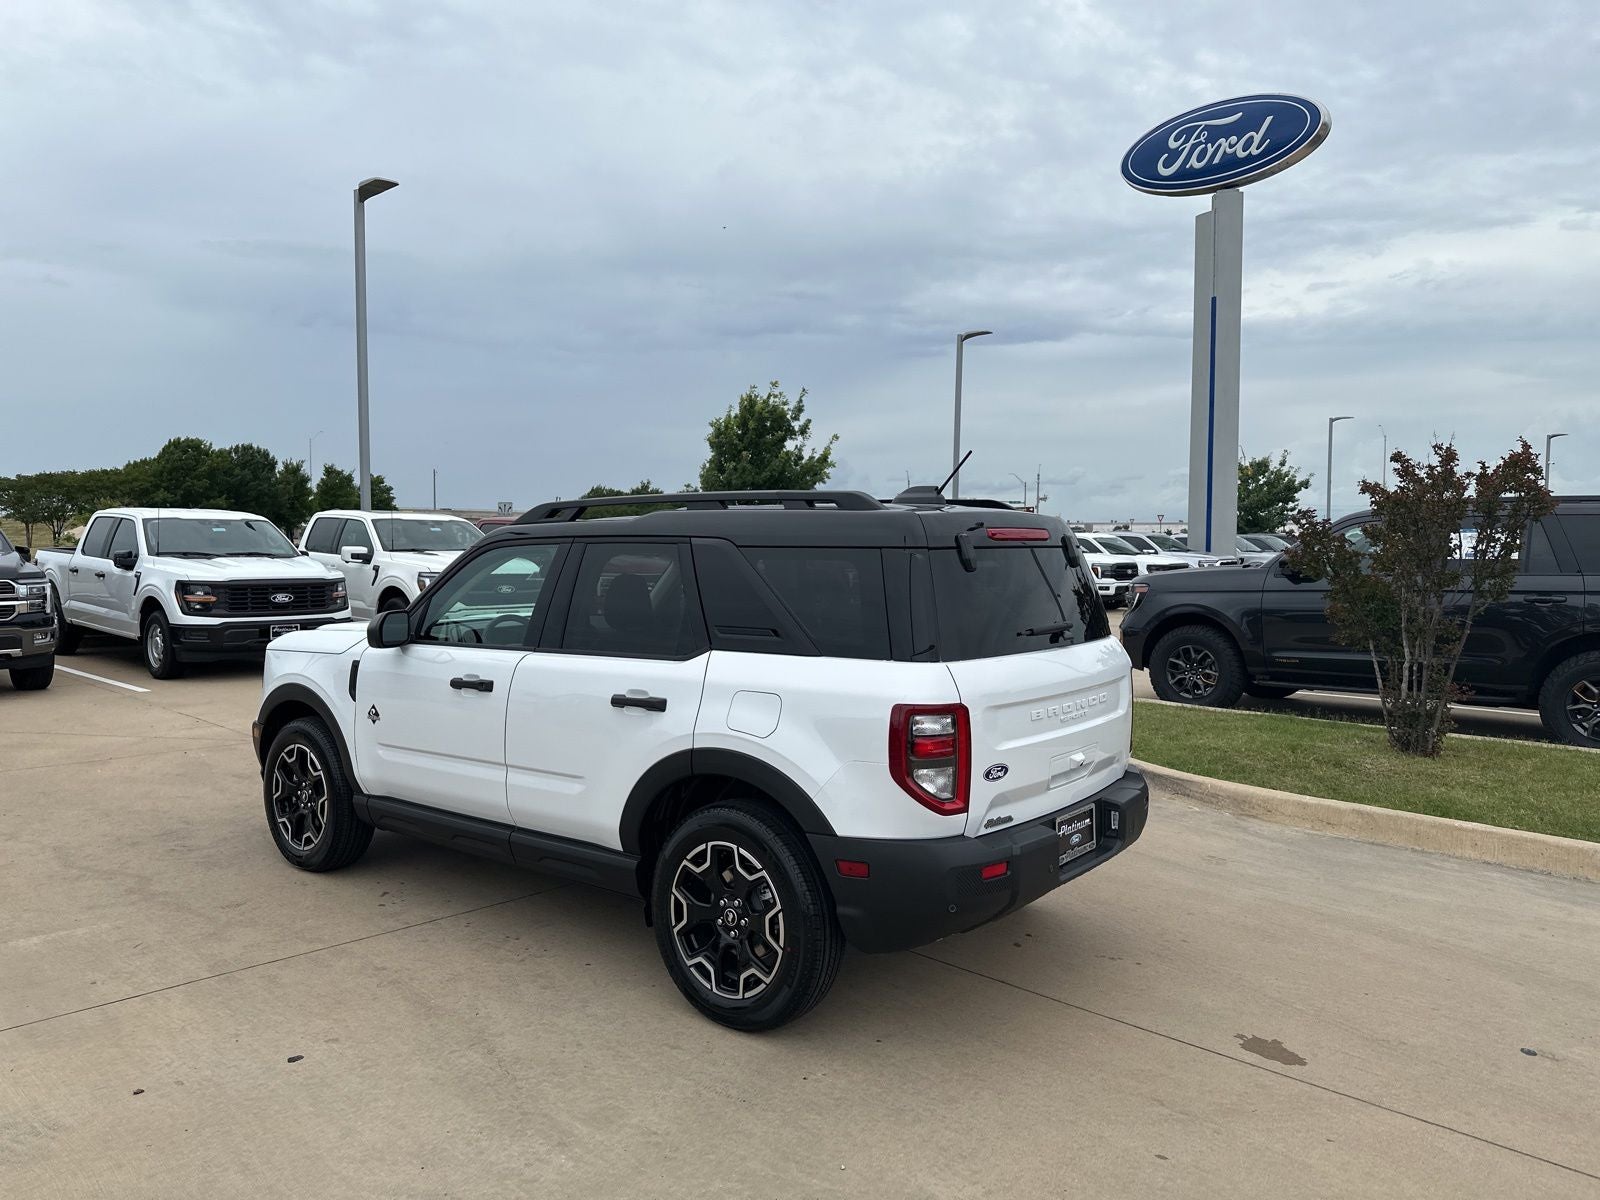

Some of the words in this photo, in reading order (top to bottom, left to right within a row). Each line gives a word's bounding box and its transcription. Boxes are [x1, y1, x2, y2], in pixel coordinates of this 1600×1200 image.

[1157, 111, 1274, 177] Ford
[1030, 692, 1107, 721] BRONCO
[1057, 818, 1092, 837] Platinum
